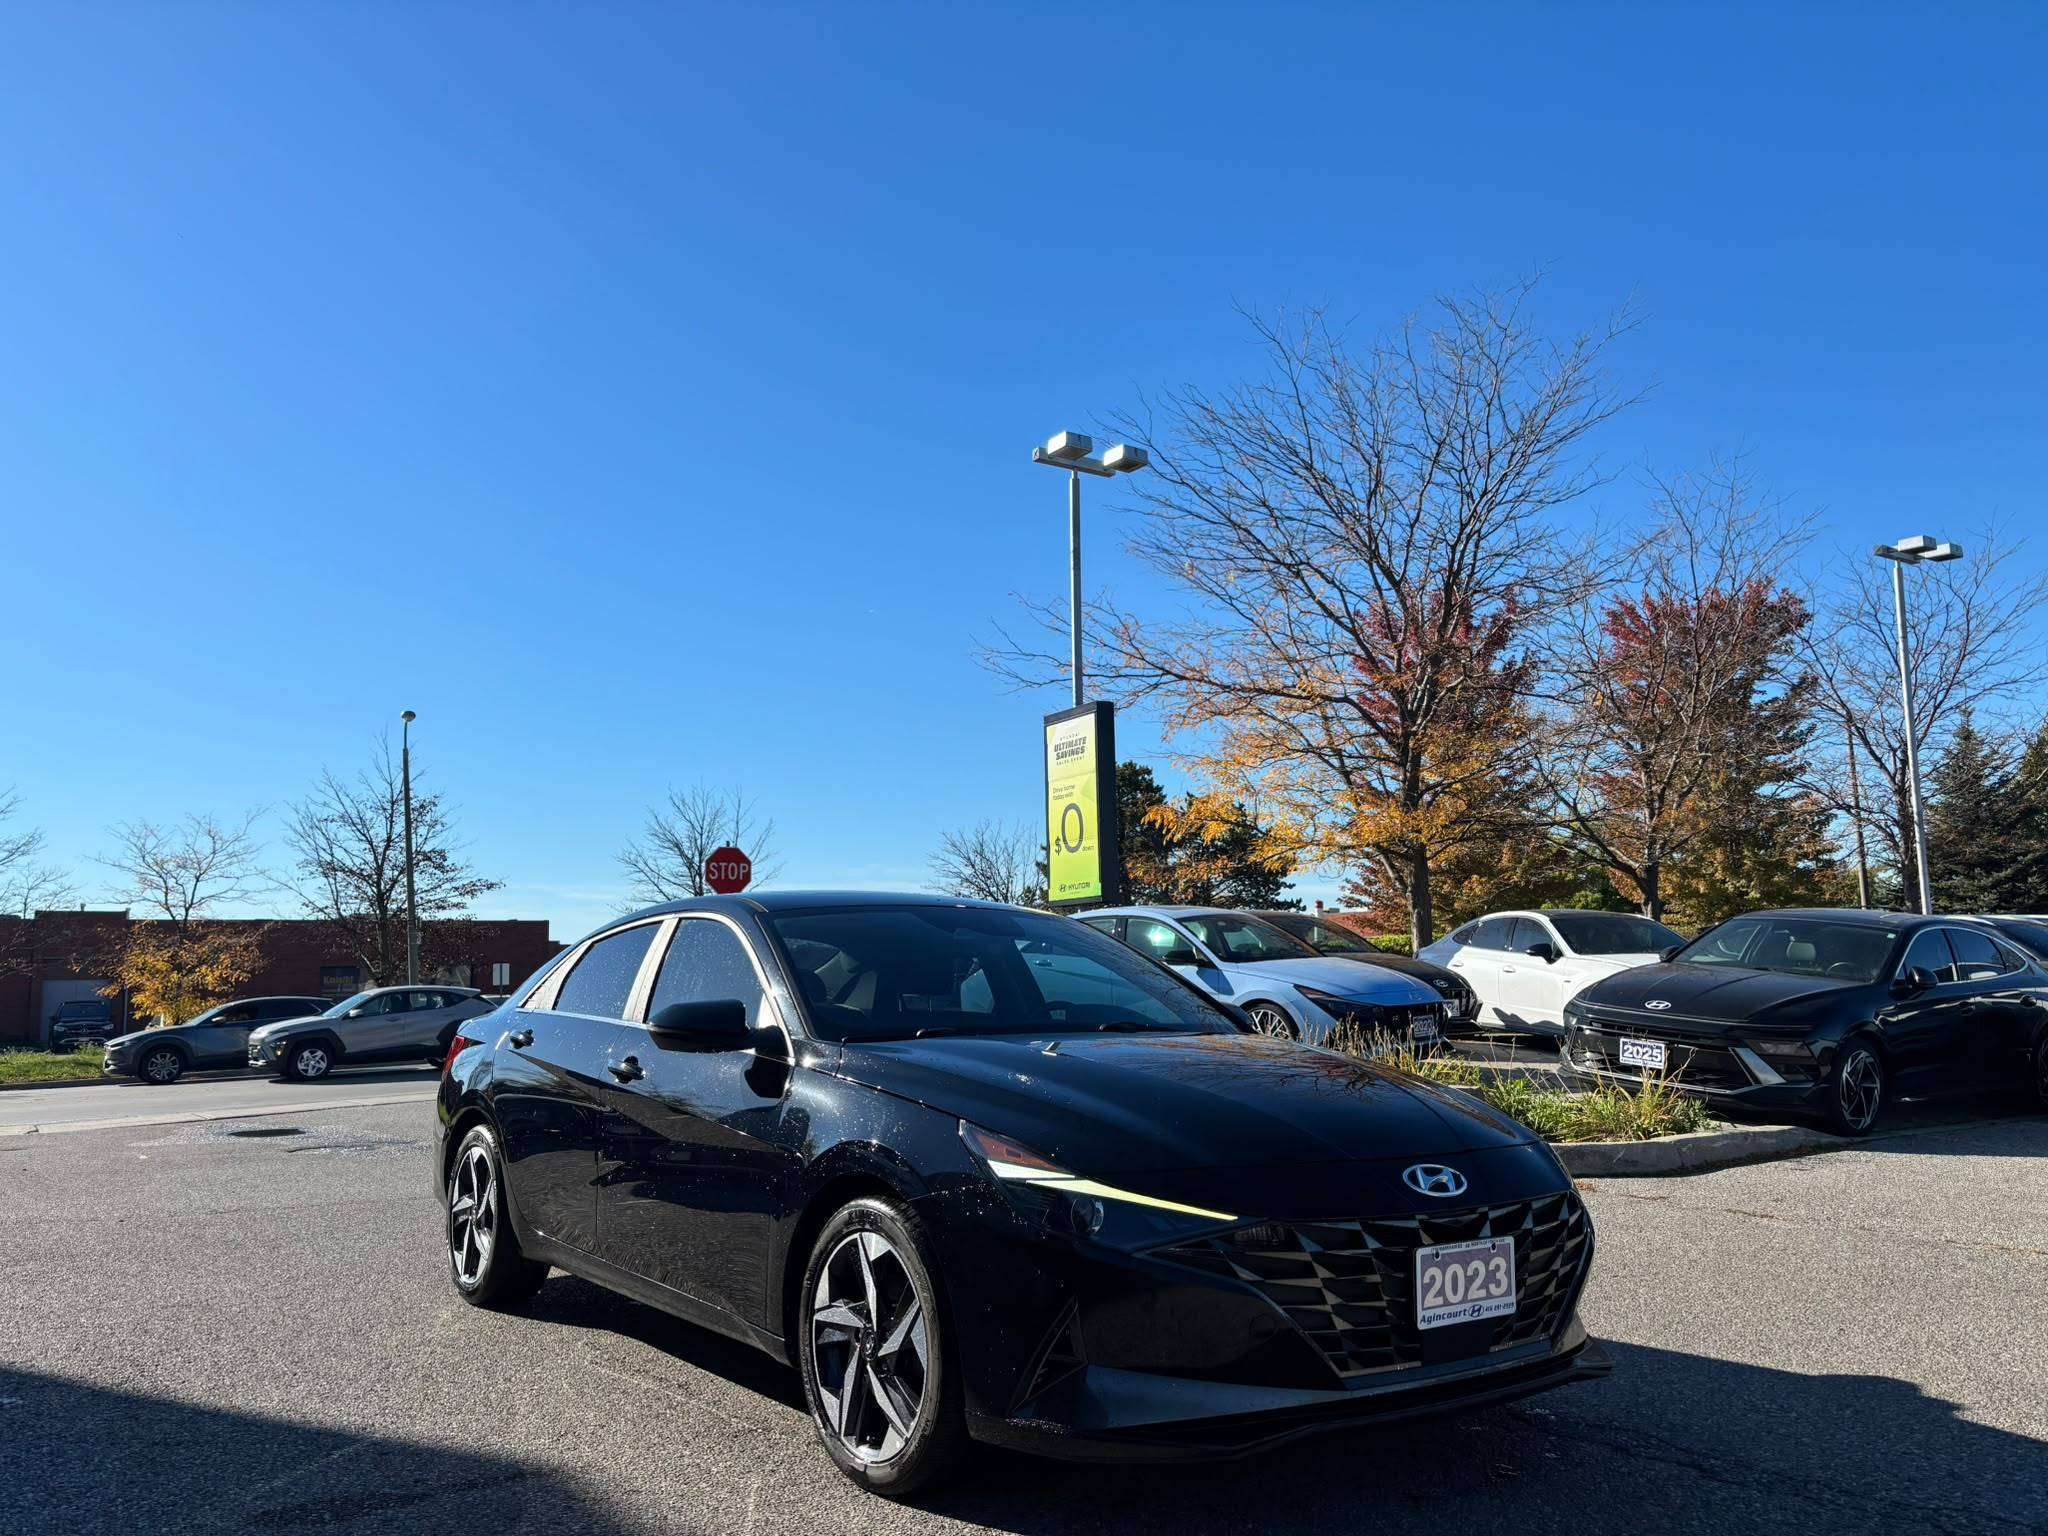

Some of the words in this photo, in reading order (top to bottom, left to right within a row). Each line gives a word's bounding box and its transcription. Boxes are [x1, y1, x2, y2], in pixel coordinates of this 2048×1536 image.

[1054, 736, 1087, 752] ULTIMATE
[1056, 746, 1086, 760] SAVINGS
[709, 862, 749, 880] STOP
[1623, 1045, 1662, 1062] 2025
[1423, 1256, 1508, 1309] 2023
[1420, 1308, 1468, 1325] Agincourt
